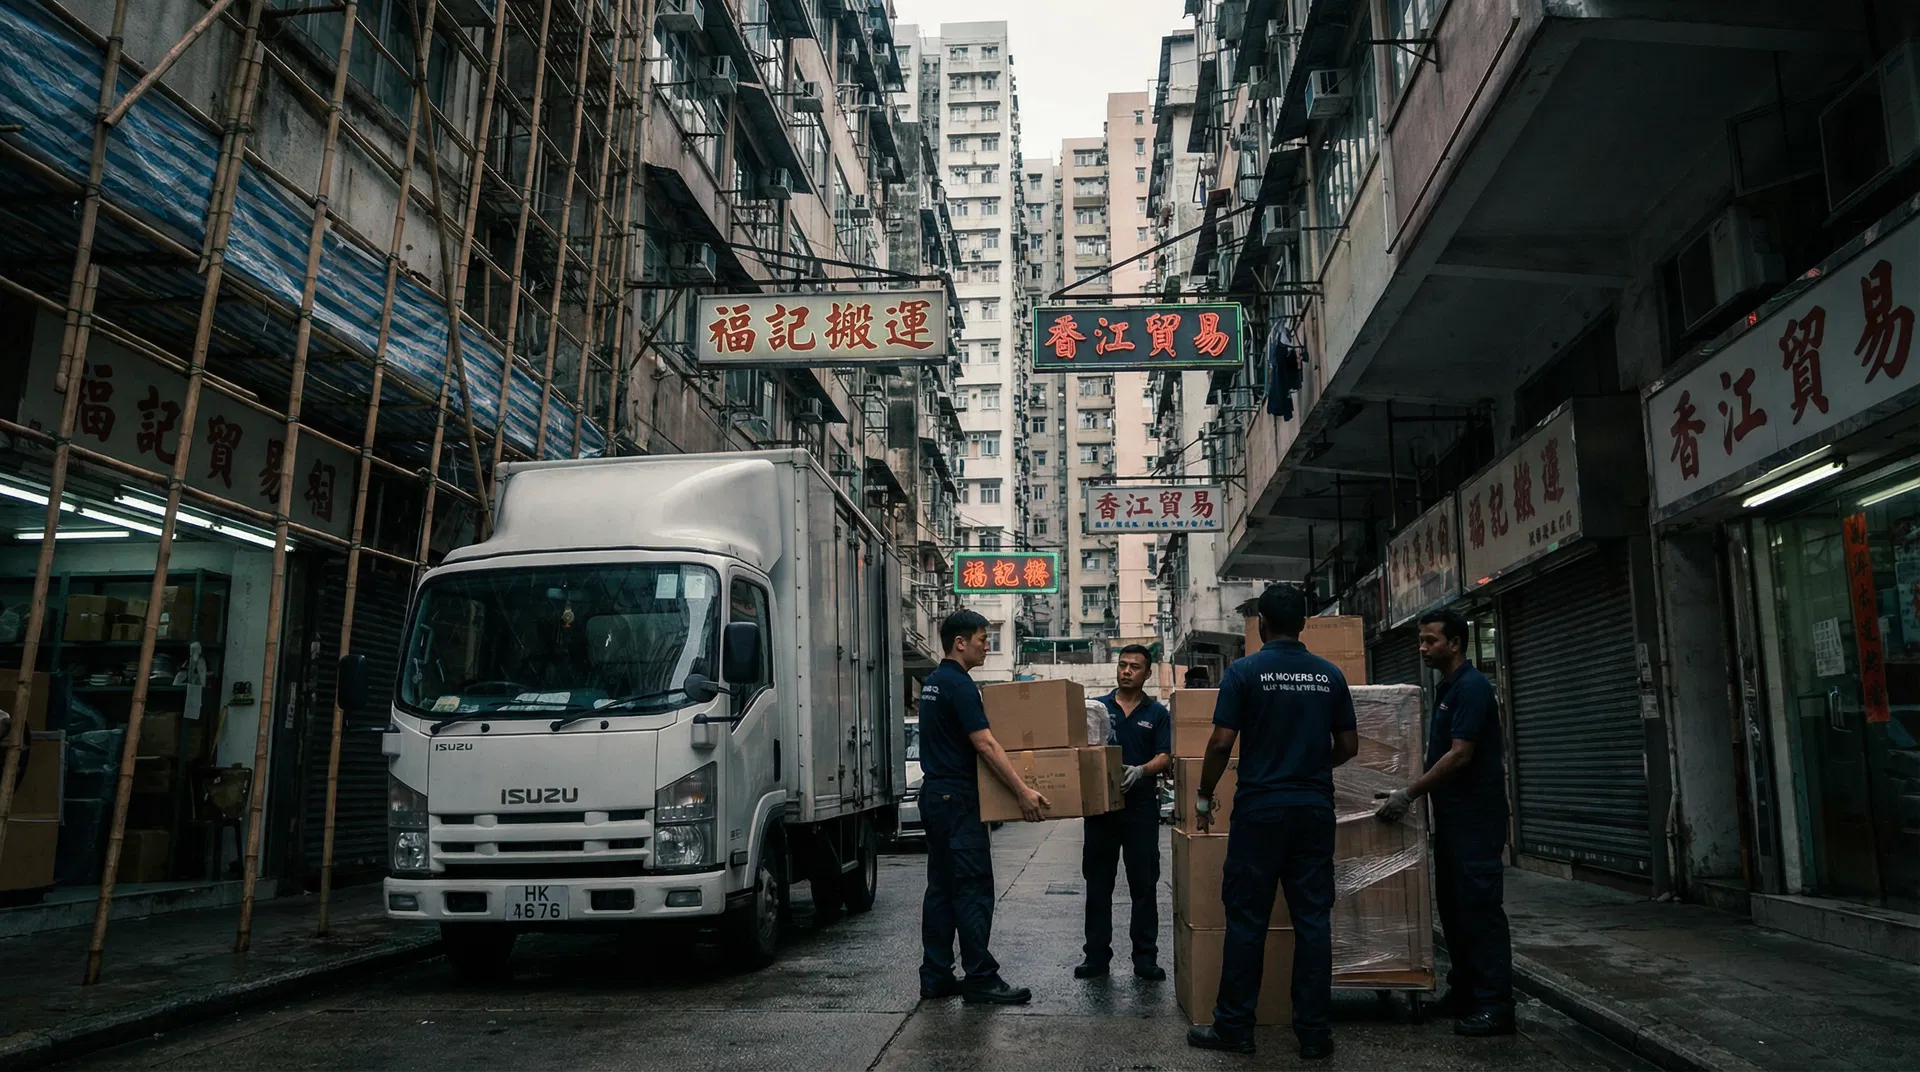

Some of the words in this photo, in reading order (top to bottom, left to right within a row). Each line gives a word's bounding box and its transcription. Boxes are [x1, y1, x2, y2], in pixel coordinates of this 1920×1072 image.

[708, 300, 935, 354] 福記搬運
[1044, 311, 1231, 359] 香江貿易
[1671, 259, 1915, 481] 香江貿易
[1095, 490, 1215, 520] 香江貿易
[1260, 673, 1275, 682] HK
[1276, 673, 1313, 682] MOVERS
[1315, 673, 1330, 683] CO.
[435, 743, 473, 751] ISUZU
[502, 788, 578, 804] ISUZU
[525, 885, 550, 901] HK
